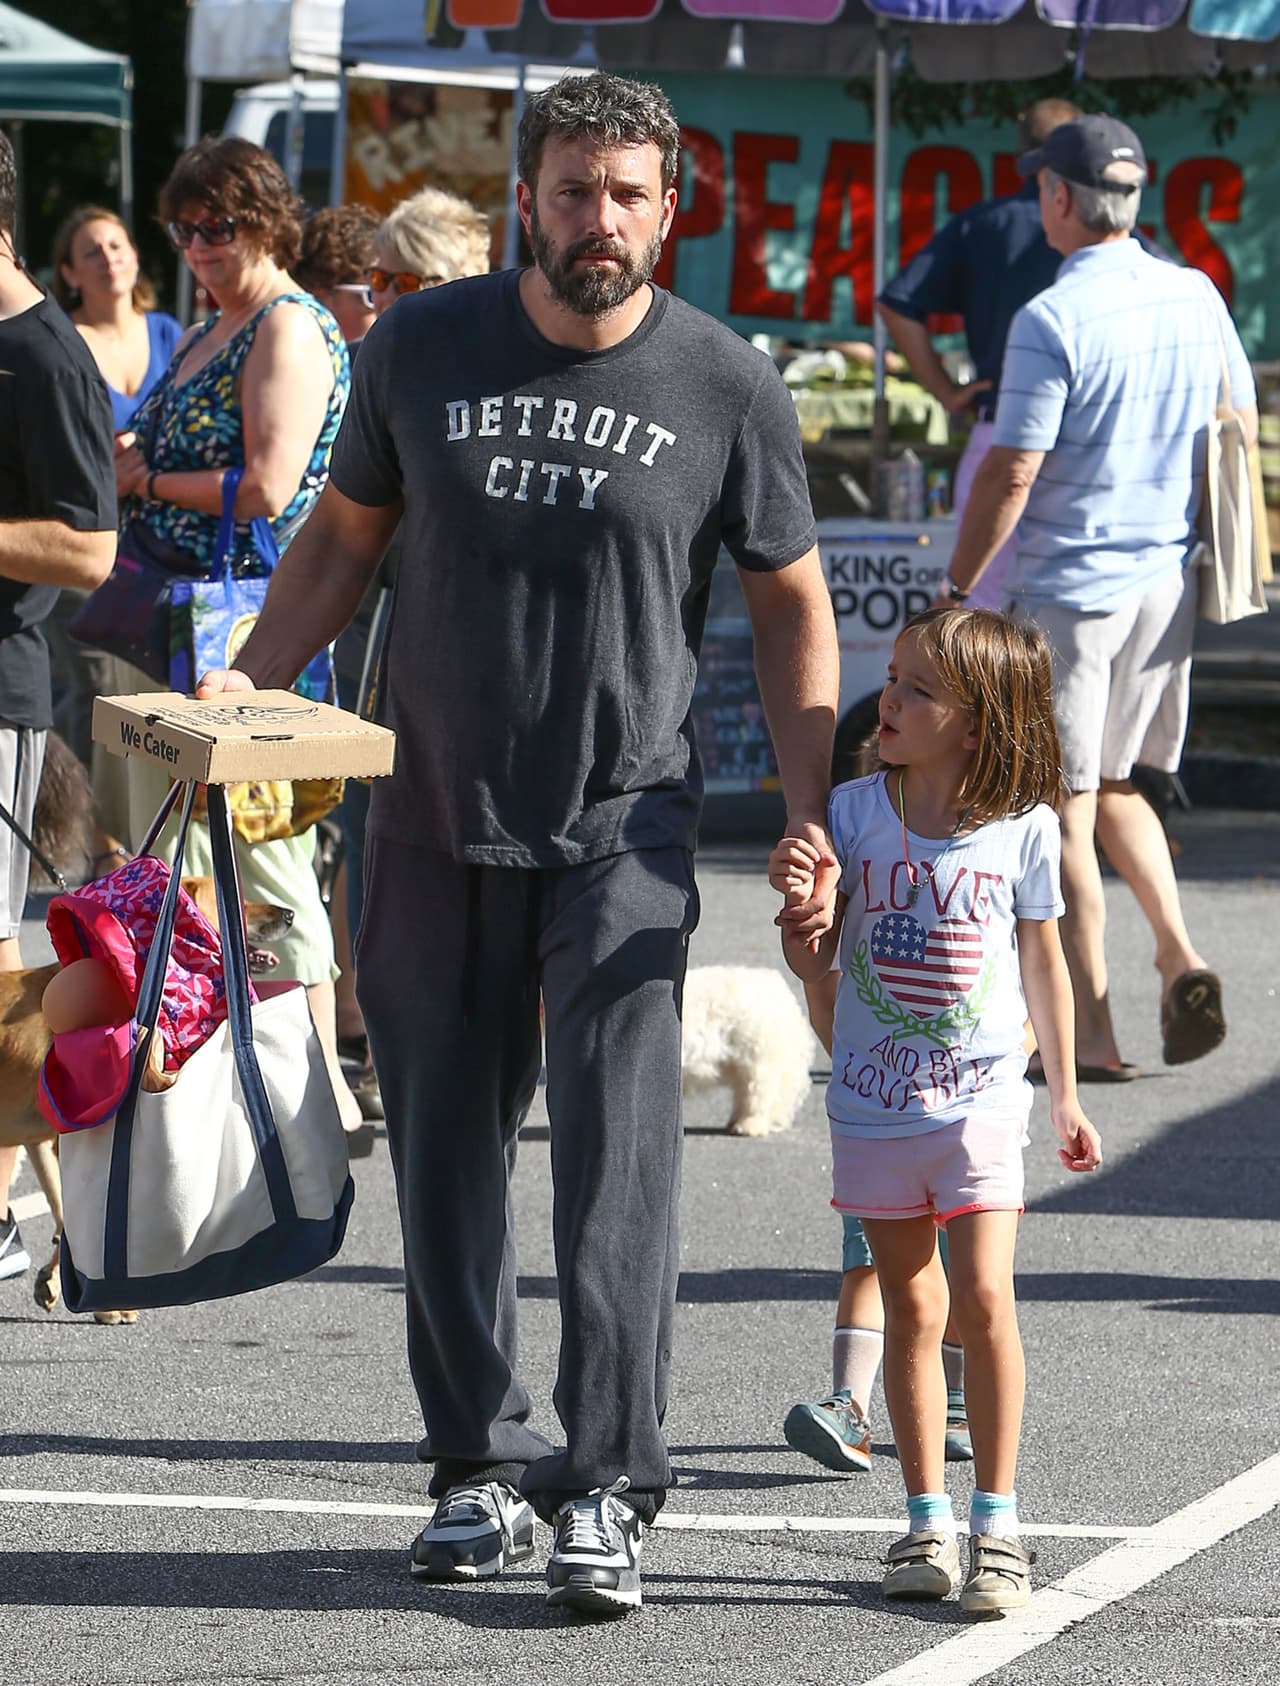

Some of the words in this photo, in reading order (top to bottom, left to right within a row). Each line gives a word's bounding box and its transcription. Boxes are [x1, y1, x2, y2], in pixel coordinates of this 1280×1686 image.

[653, 125, 1244, 334] PEACS
[446, 396, 678, 467] DETROIT
[484, 455, 609, 510] CITY
[829, 554, 911, 585] KING
[121, 721, 141, 749] We
[143, 731, 180, 764] Cater
[862, 859, 1001, 927] LOVE
[869, 1035, 920, 1077] AND
[928, 1045, 962, 1072] BE
